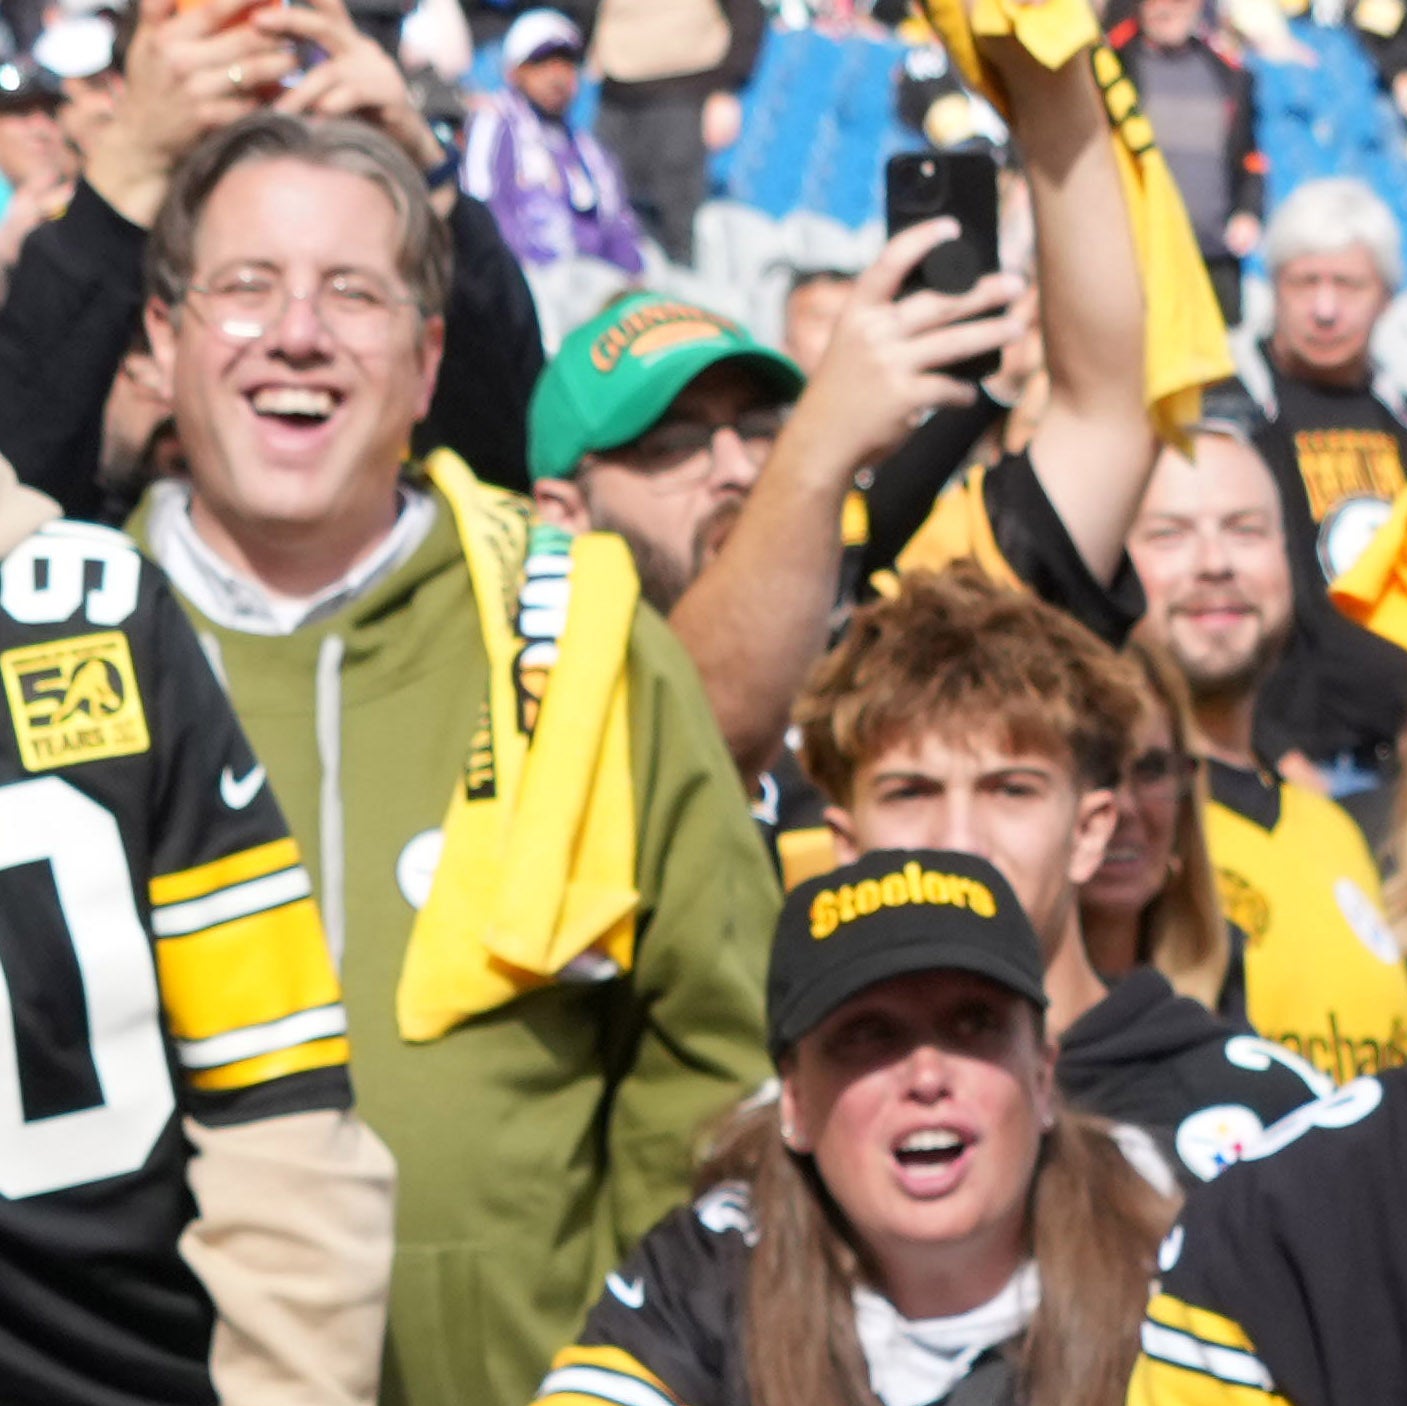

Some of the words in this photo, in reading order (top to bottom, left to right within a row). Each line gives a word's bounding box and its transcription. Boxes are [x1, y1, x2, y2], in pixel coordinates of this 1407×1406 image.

[18, 657, 126, 727] 50
[31, 726, 105, 759] YEARS
[809, 860, 998, 939] Steelers
